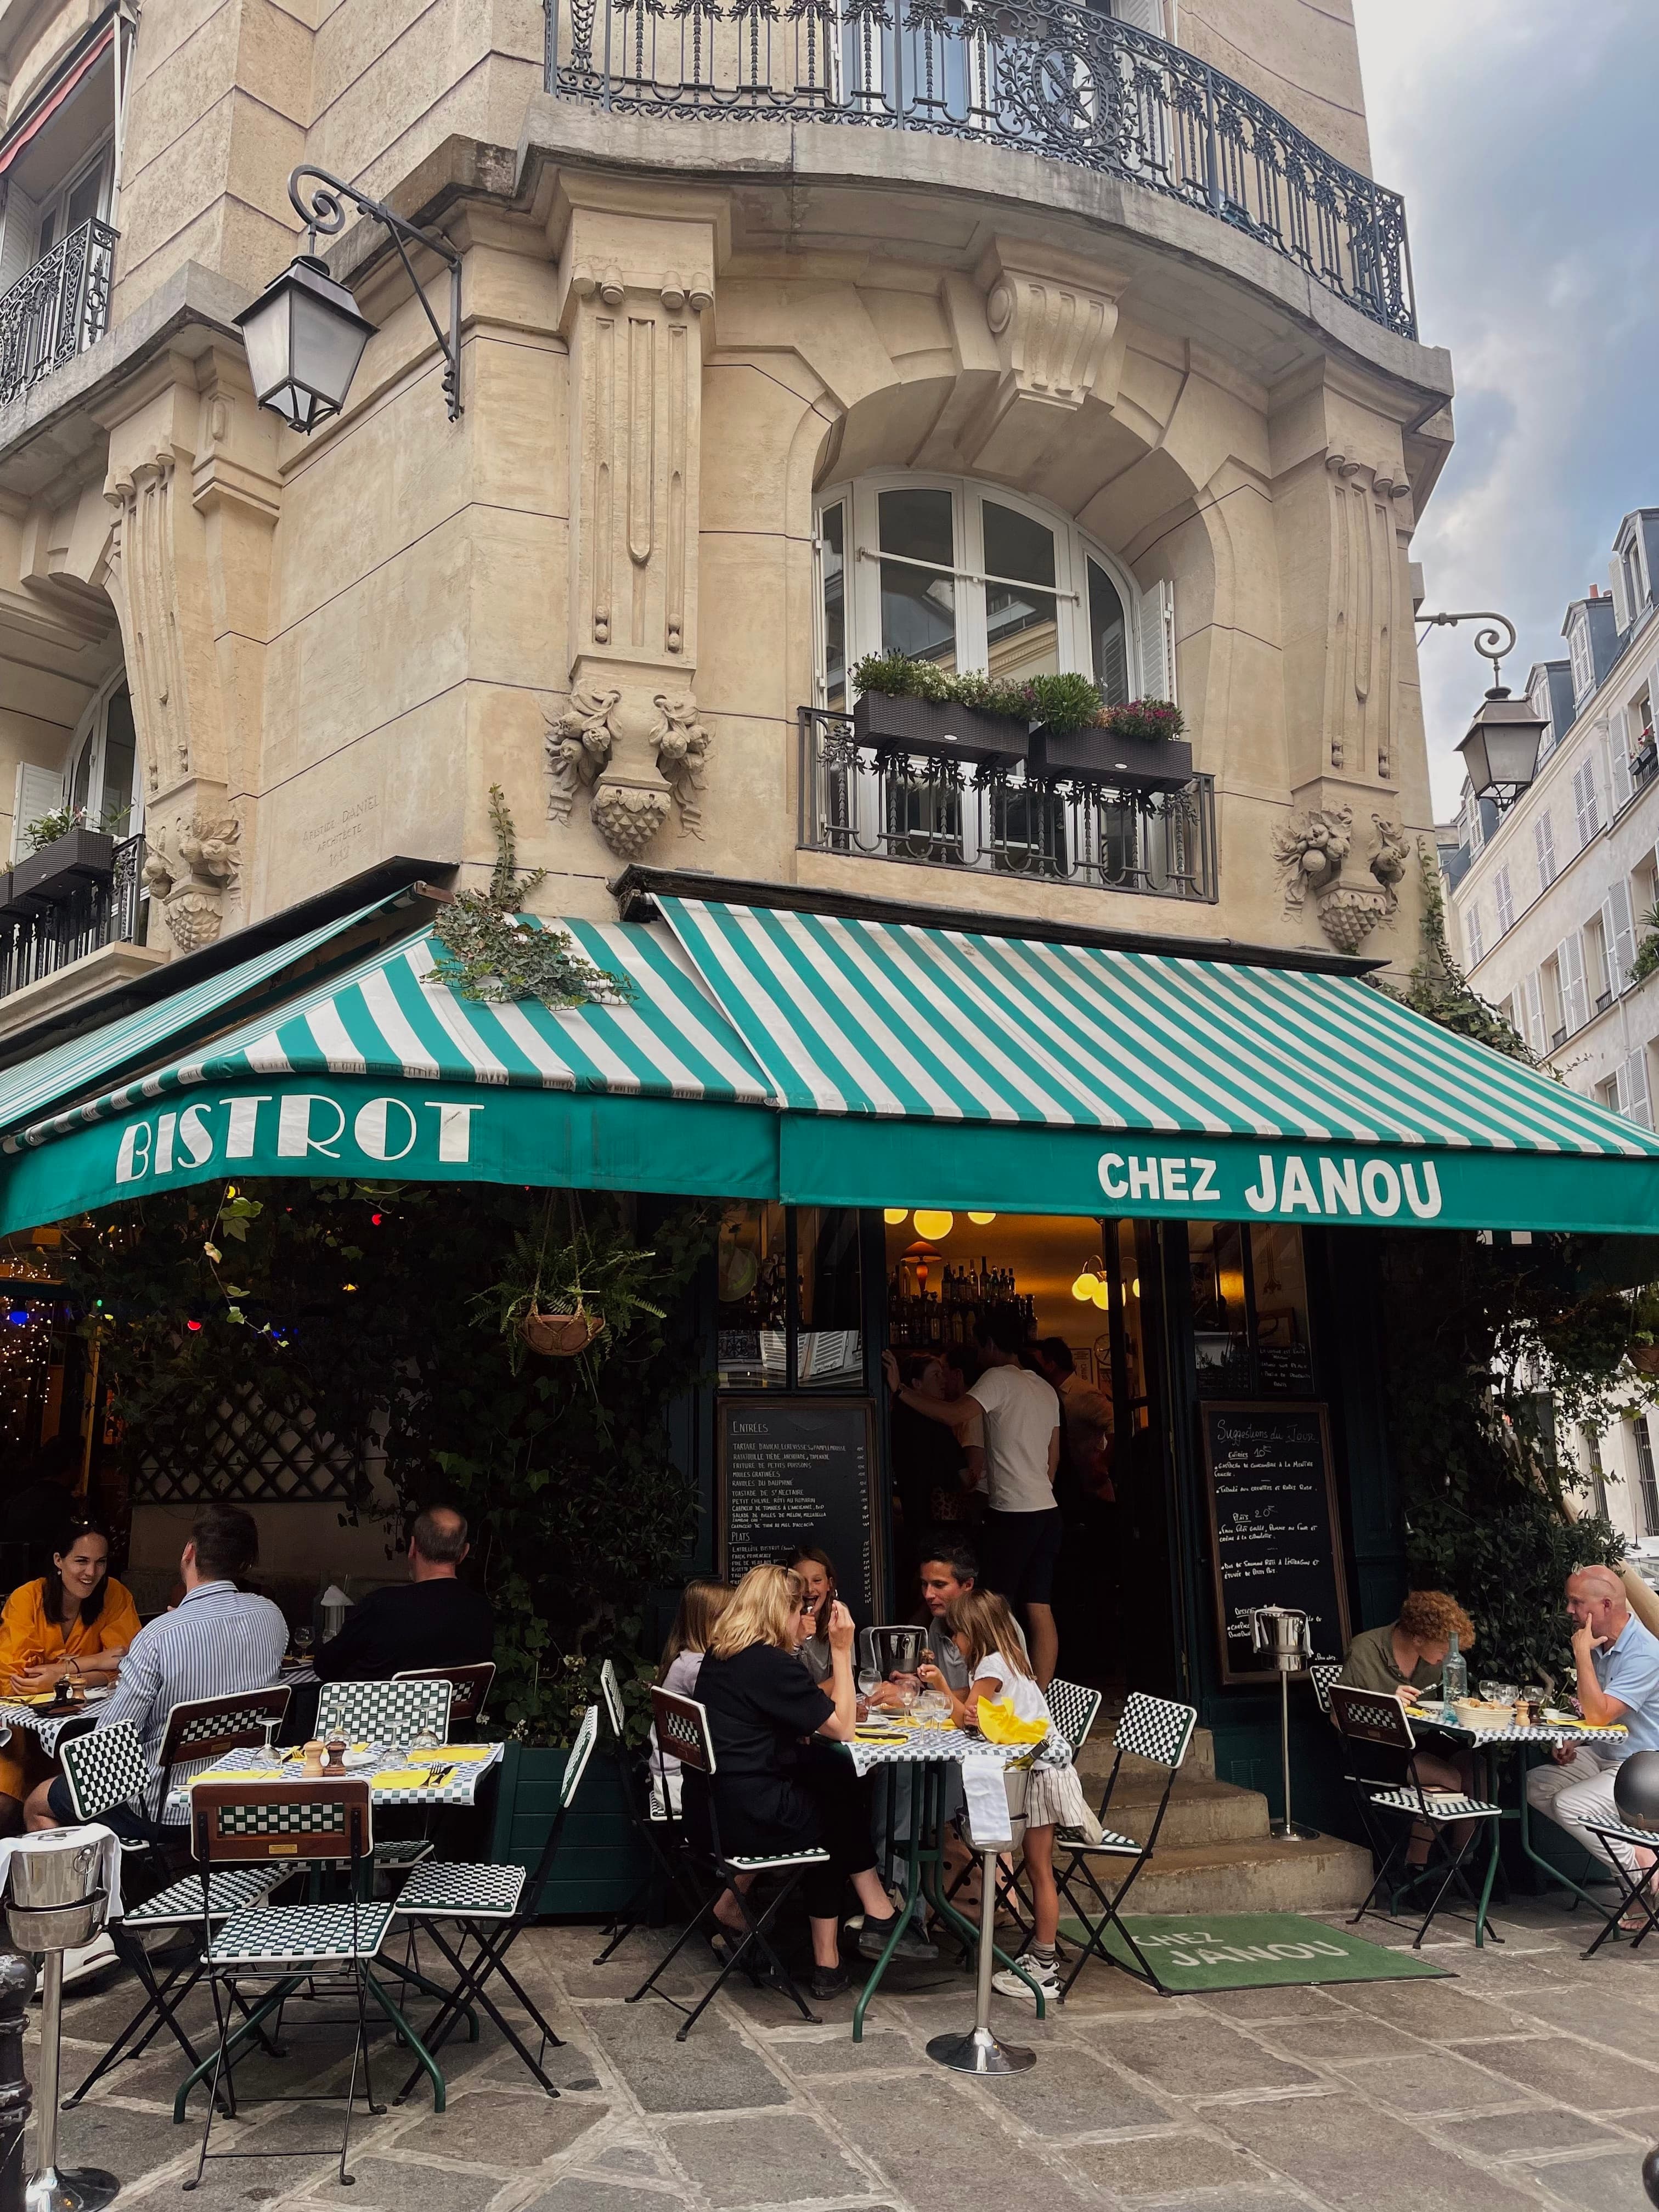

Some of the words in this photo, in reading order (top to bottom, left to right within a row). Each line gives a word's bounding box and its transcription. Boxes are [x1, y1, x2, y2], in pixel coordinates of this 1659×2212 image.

[303, 820, 335, 842] ARISTIDE
[342, 795, 379, 823] DANIEL
[317, 823, 362, 853] ARCHITECTE
[115, 1094, 485, 1184] BISTROT
[1098, 1153, 1221, 1200] CHEZ
[1244, 1154, 1442, 1218] JANOU
[1217, 1419, 1268, 1446] Suggestions
[1270, 1426, 1283, 1440] du
[731, 1532, 750, 1541] PLATS
[1131, 1932, 1224, 1947] CHEZ
[1169, 1940, 1350, 1967] JANOU
